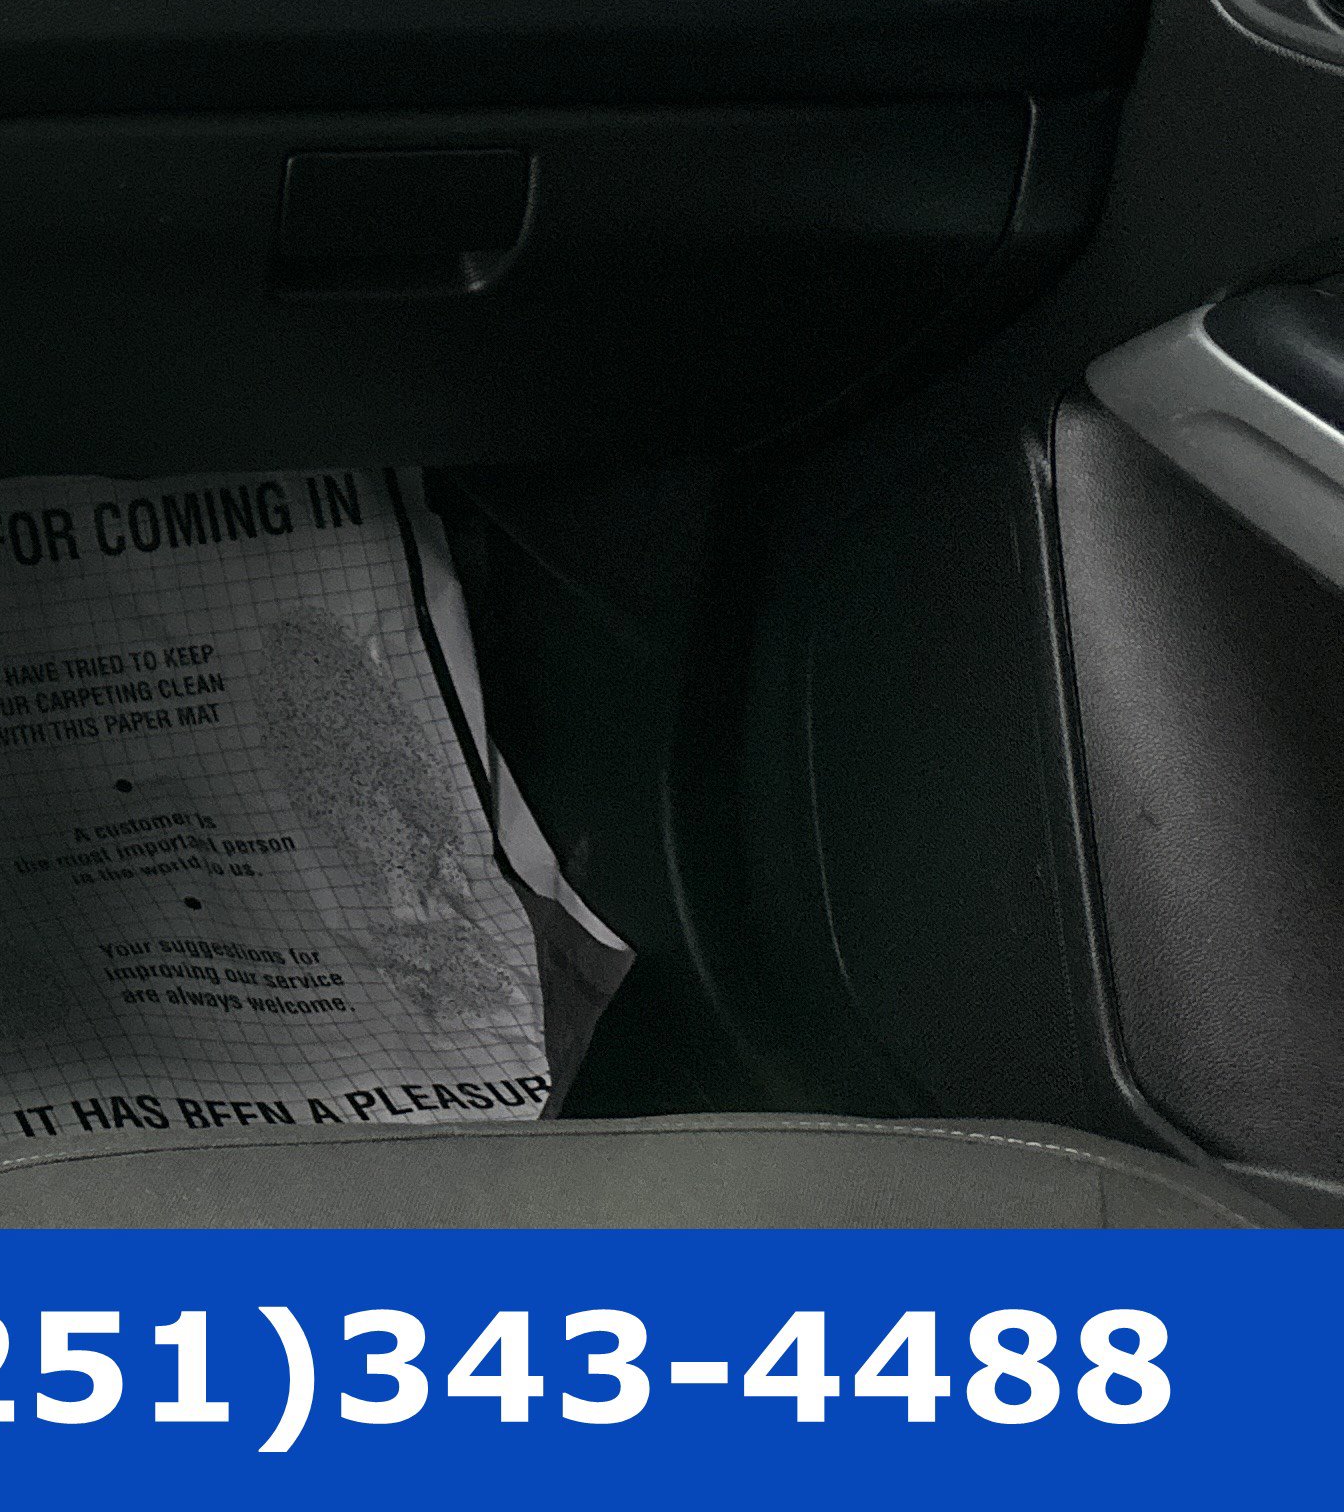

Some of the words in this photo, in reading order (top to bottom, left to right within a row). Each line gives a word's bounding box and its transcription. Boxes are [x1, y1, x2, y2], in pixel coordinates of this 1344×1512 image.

[94, 480, 294, 557] COMING
[308, 473, 363, 530] IN
[2, 661, 61, 687] HAVE
[62, 653, 124, 680] TRIED
[131, 649, 158, 672] TO
[164, 643, 215, 668] KEEP
[34, 679, 154, 715] CARPETING
[157, 671, 226, 699] CLEAN
[48, 716, 101, 743] THIS
[105, 708, 173, 736] PAPER
[177, 701, 222, 727] MAT
[74, 826, 92, 844] A
[95, 813, 192, 841] customer
[221, 834, 296, 858] person
[140, 853, 201, 877] world
[229, 859, 264, 878] us.
[99, 940, 152, 959] Your
[160, 937, 286, 966] suggestions
[288, 944, 321, 966] for
[104, 962, 220, 987] improving
[225, 969, 258, 986] our
[264, 969, 345, 991] service
[123, 986, 159, 1004] are
[165, 984, 243, 1012] always
[247, 994, 356, 1016] welcome.
[14, 1103, 55, 1140] IT
[73, 1092, 170, 1134] HAS
[310, 1096, 341, 1127] A
